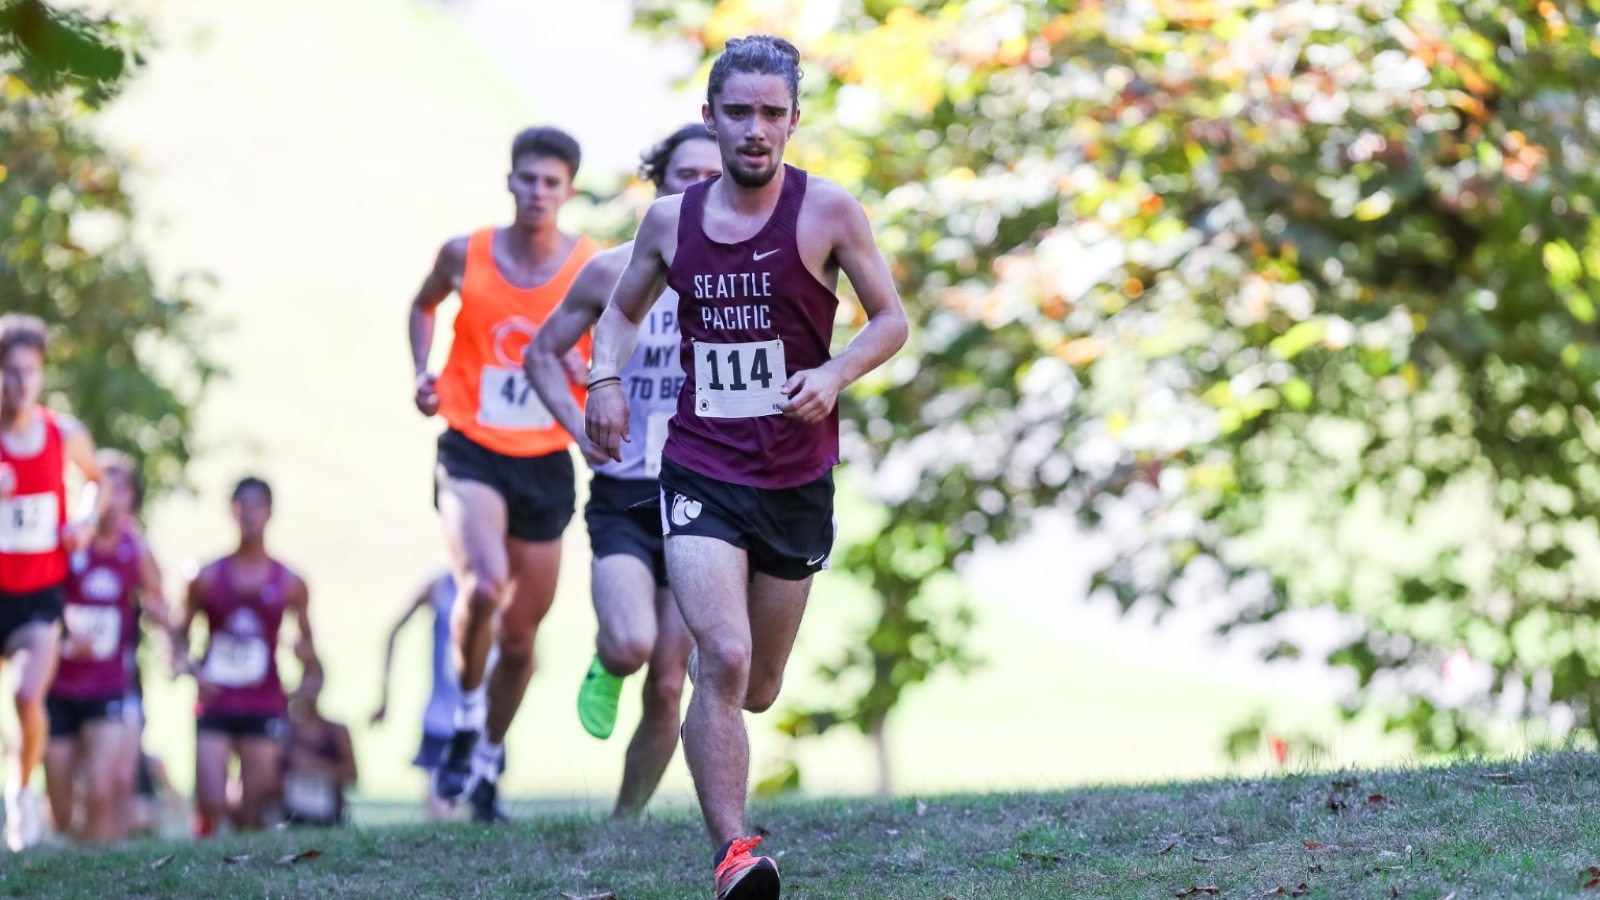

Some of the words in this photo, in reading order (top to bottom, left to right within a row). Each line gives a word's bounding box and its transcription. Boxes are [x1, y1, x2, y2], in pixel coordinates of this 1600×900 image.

[694, 272, 772, 299] SEATTLE
[701, 305, 771, 331] PACIFIC
[643, 345, 675, 368] MY
[706, 347, 773, 391] 114
[630, 376, 653, 400] TO
